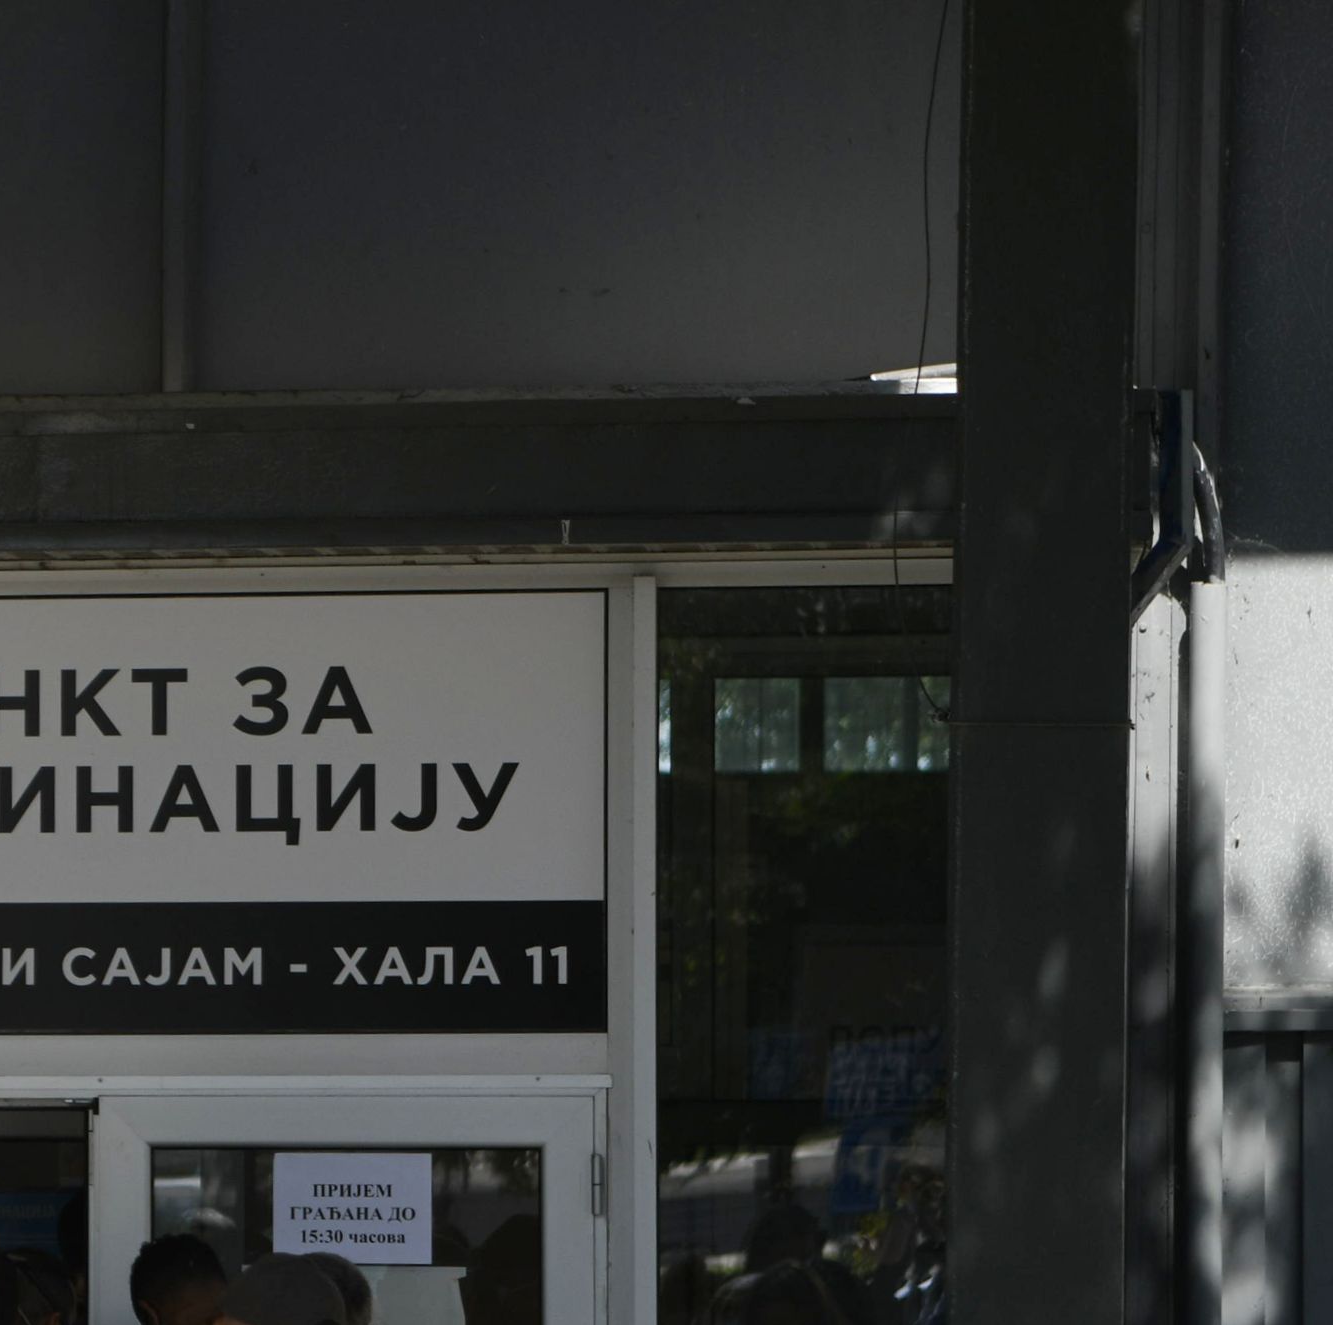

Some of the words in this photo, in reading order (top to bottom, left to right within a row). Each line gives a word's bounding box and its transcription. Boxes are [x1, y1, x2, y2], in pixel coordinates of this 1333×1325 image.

[233, 665, 373, 736] ЗА
[61, 945, 264, 987] САЈАМ
[333, 945, 501, 987] ХАЛА
[525, 945, 569, 986] 11
[313, 1183, 393, 1198] ПРИЈЕМ
[289, 1207, 383, 1221] ГРАЂАНА
[388, 1207, 416, 1222] ДО
[301, 1229, 343, 1244] 15:30
[348, 1232, 406, 1244] часова
